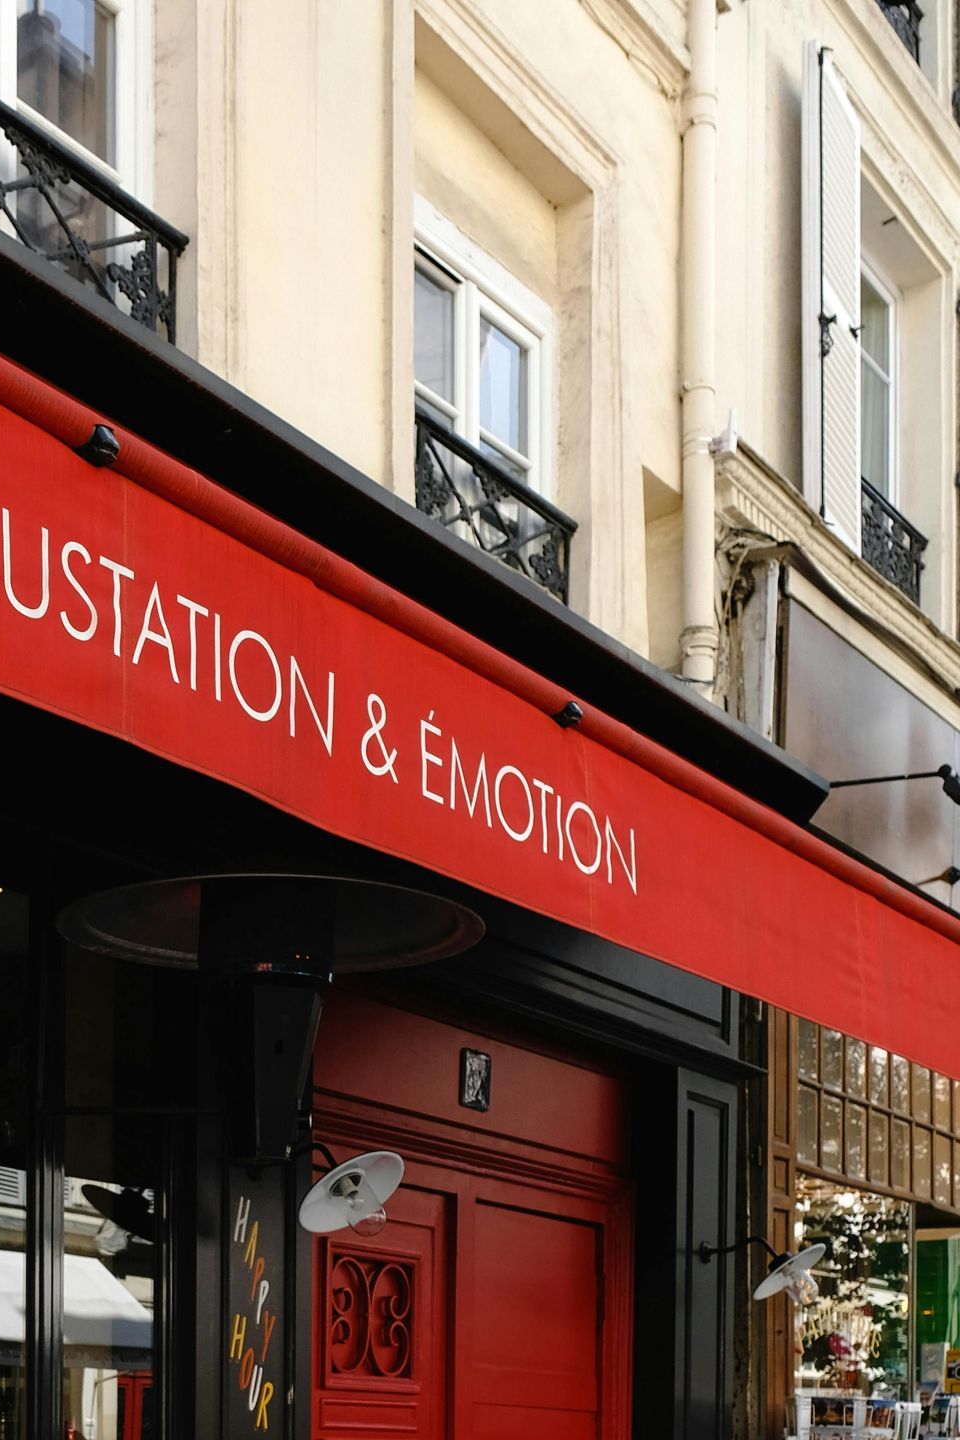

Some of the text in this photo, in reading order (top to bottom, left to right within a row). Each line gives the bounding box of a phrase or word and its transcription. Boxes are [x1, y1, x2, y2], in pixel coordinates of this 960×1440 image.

[360, 692, 399, 785] &
[420, 709, 639, 896] ÉMOTION
[233, 1195, 276, 1363] HAPPY
[229, 1313, 275, 1431] HOUR
